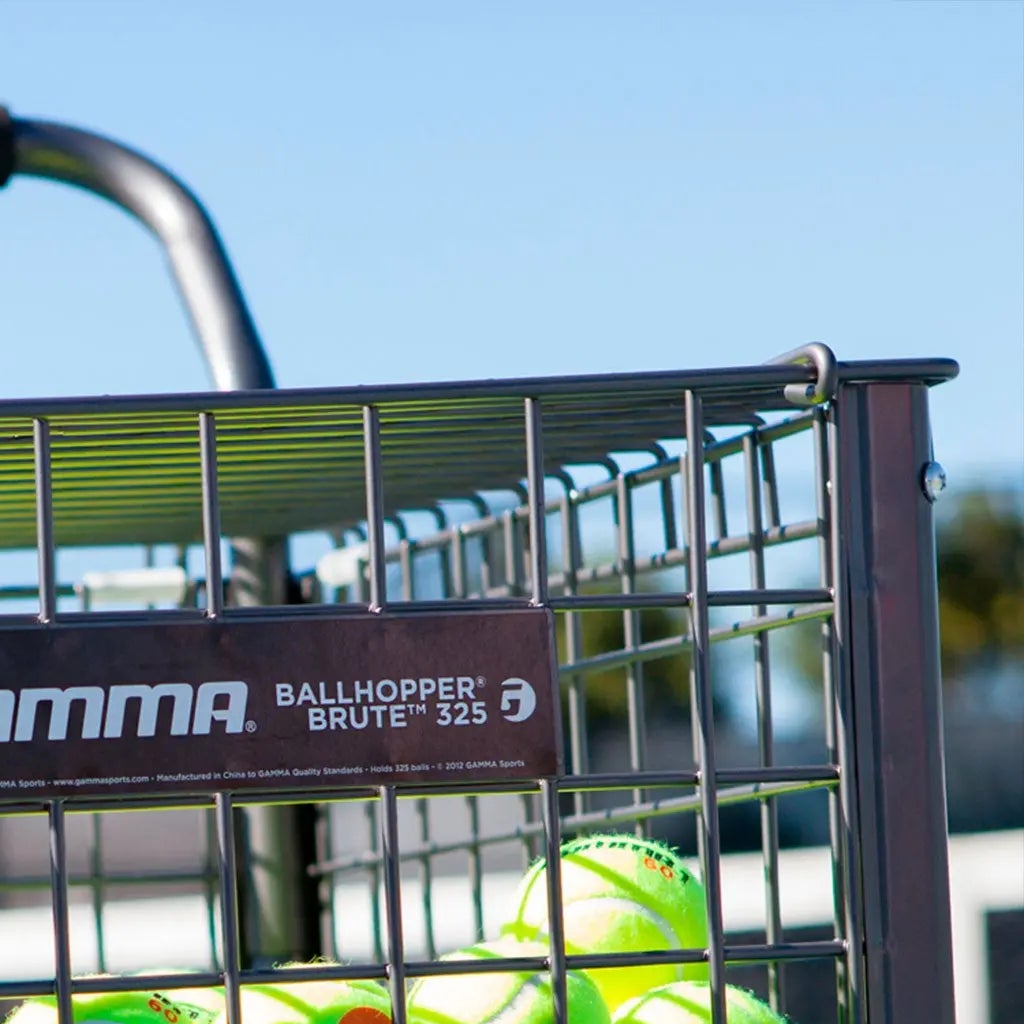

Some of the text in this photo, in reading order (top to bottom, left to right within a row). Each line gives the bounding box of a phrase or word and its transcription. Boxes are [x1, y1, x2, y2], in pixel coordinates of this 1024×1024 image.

[435, 701, 488, 726] 325
[18, 779, 46, 789] Sports
[53, 775, 150, 787] www.gammasports.com
[156, 772, 212, 782] Manufactured
[213, 771, 222, 780] in
[223, 770, 246, 780] China
[247, 769, 257, 779] to
[257, 768, 291, 779] GAMMA
[292, 767, 321, 777] Quality
[323, 766, 363, 776] Standards
[370, 765, 393, 774] Holds
[395, 763, 410, 773] 325
[410, 762, 430, 772] balls
[445, 761, 465, 771] 2012
[465, 760, 497, 770] GAMMA
[498, 759, 526, 769] Sports
